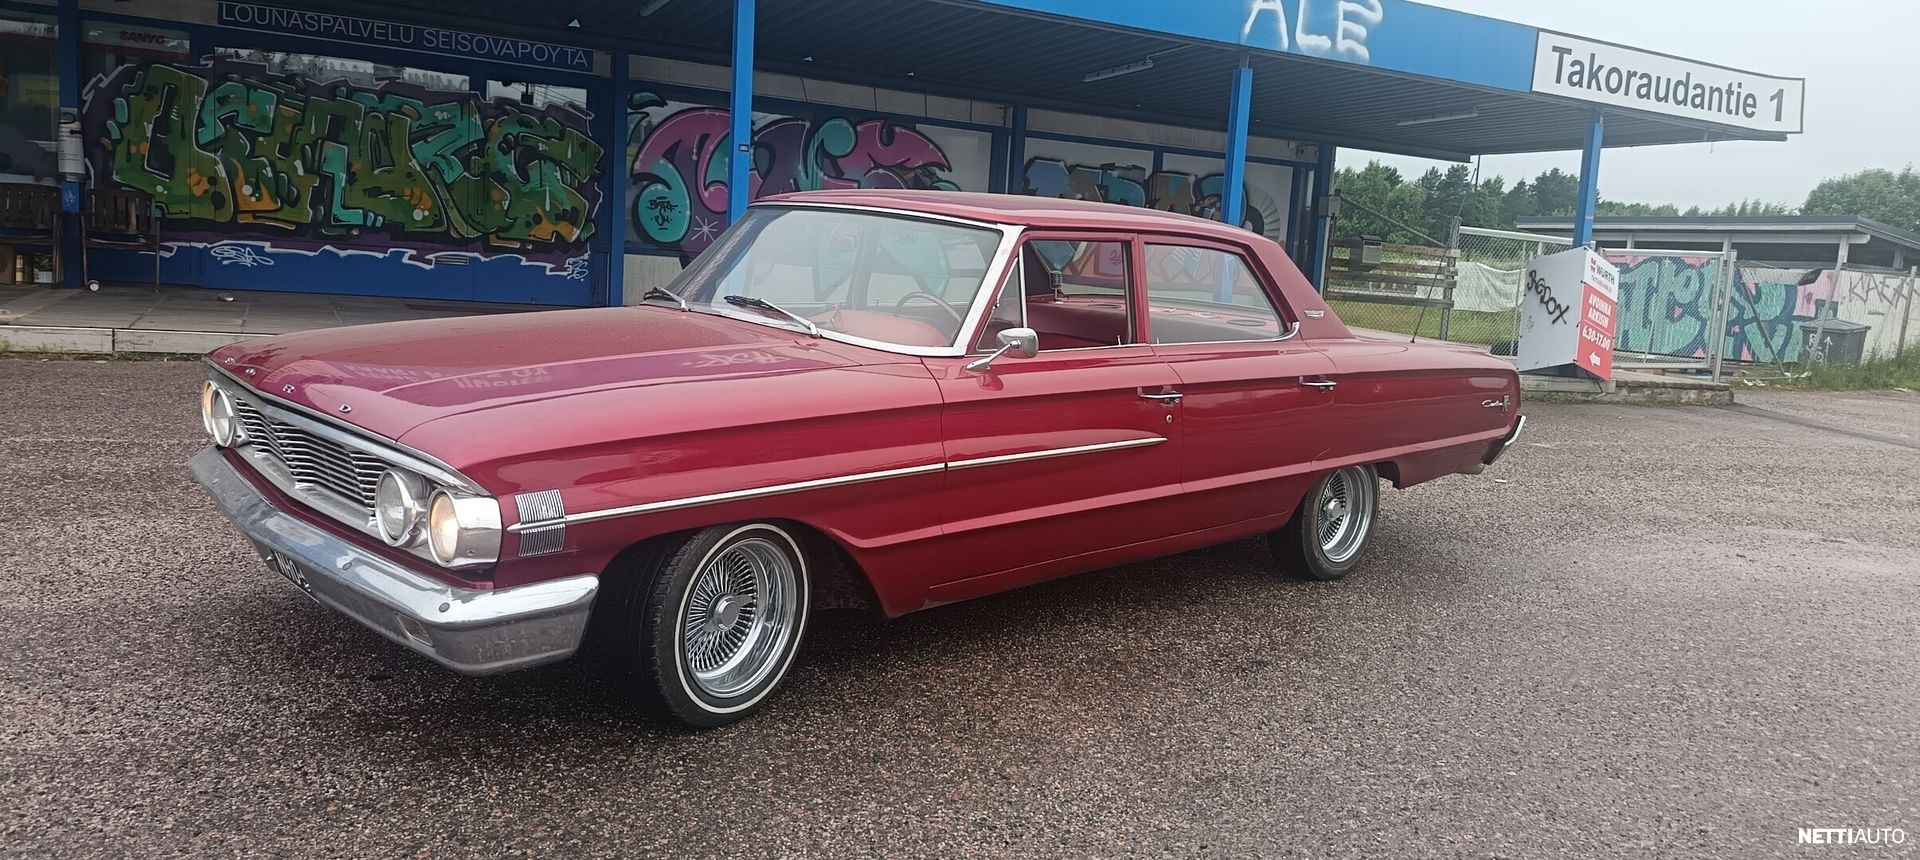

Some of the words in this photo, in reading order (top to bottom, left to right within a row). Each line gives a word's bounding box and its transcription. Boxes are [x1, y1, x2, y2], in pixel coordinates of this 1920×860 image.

[222, 3, 414, 43] LOUNASPALVELU
[1552, 45, 1757, 118] Takoraudantie
[1769, 88, 1785, 122] 1
